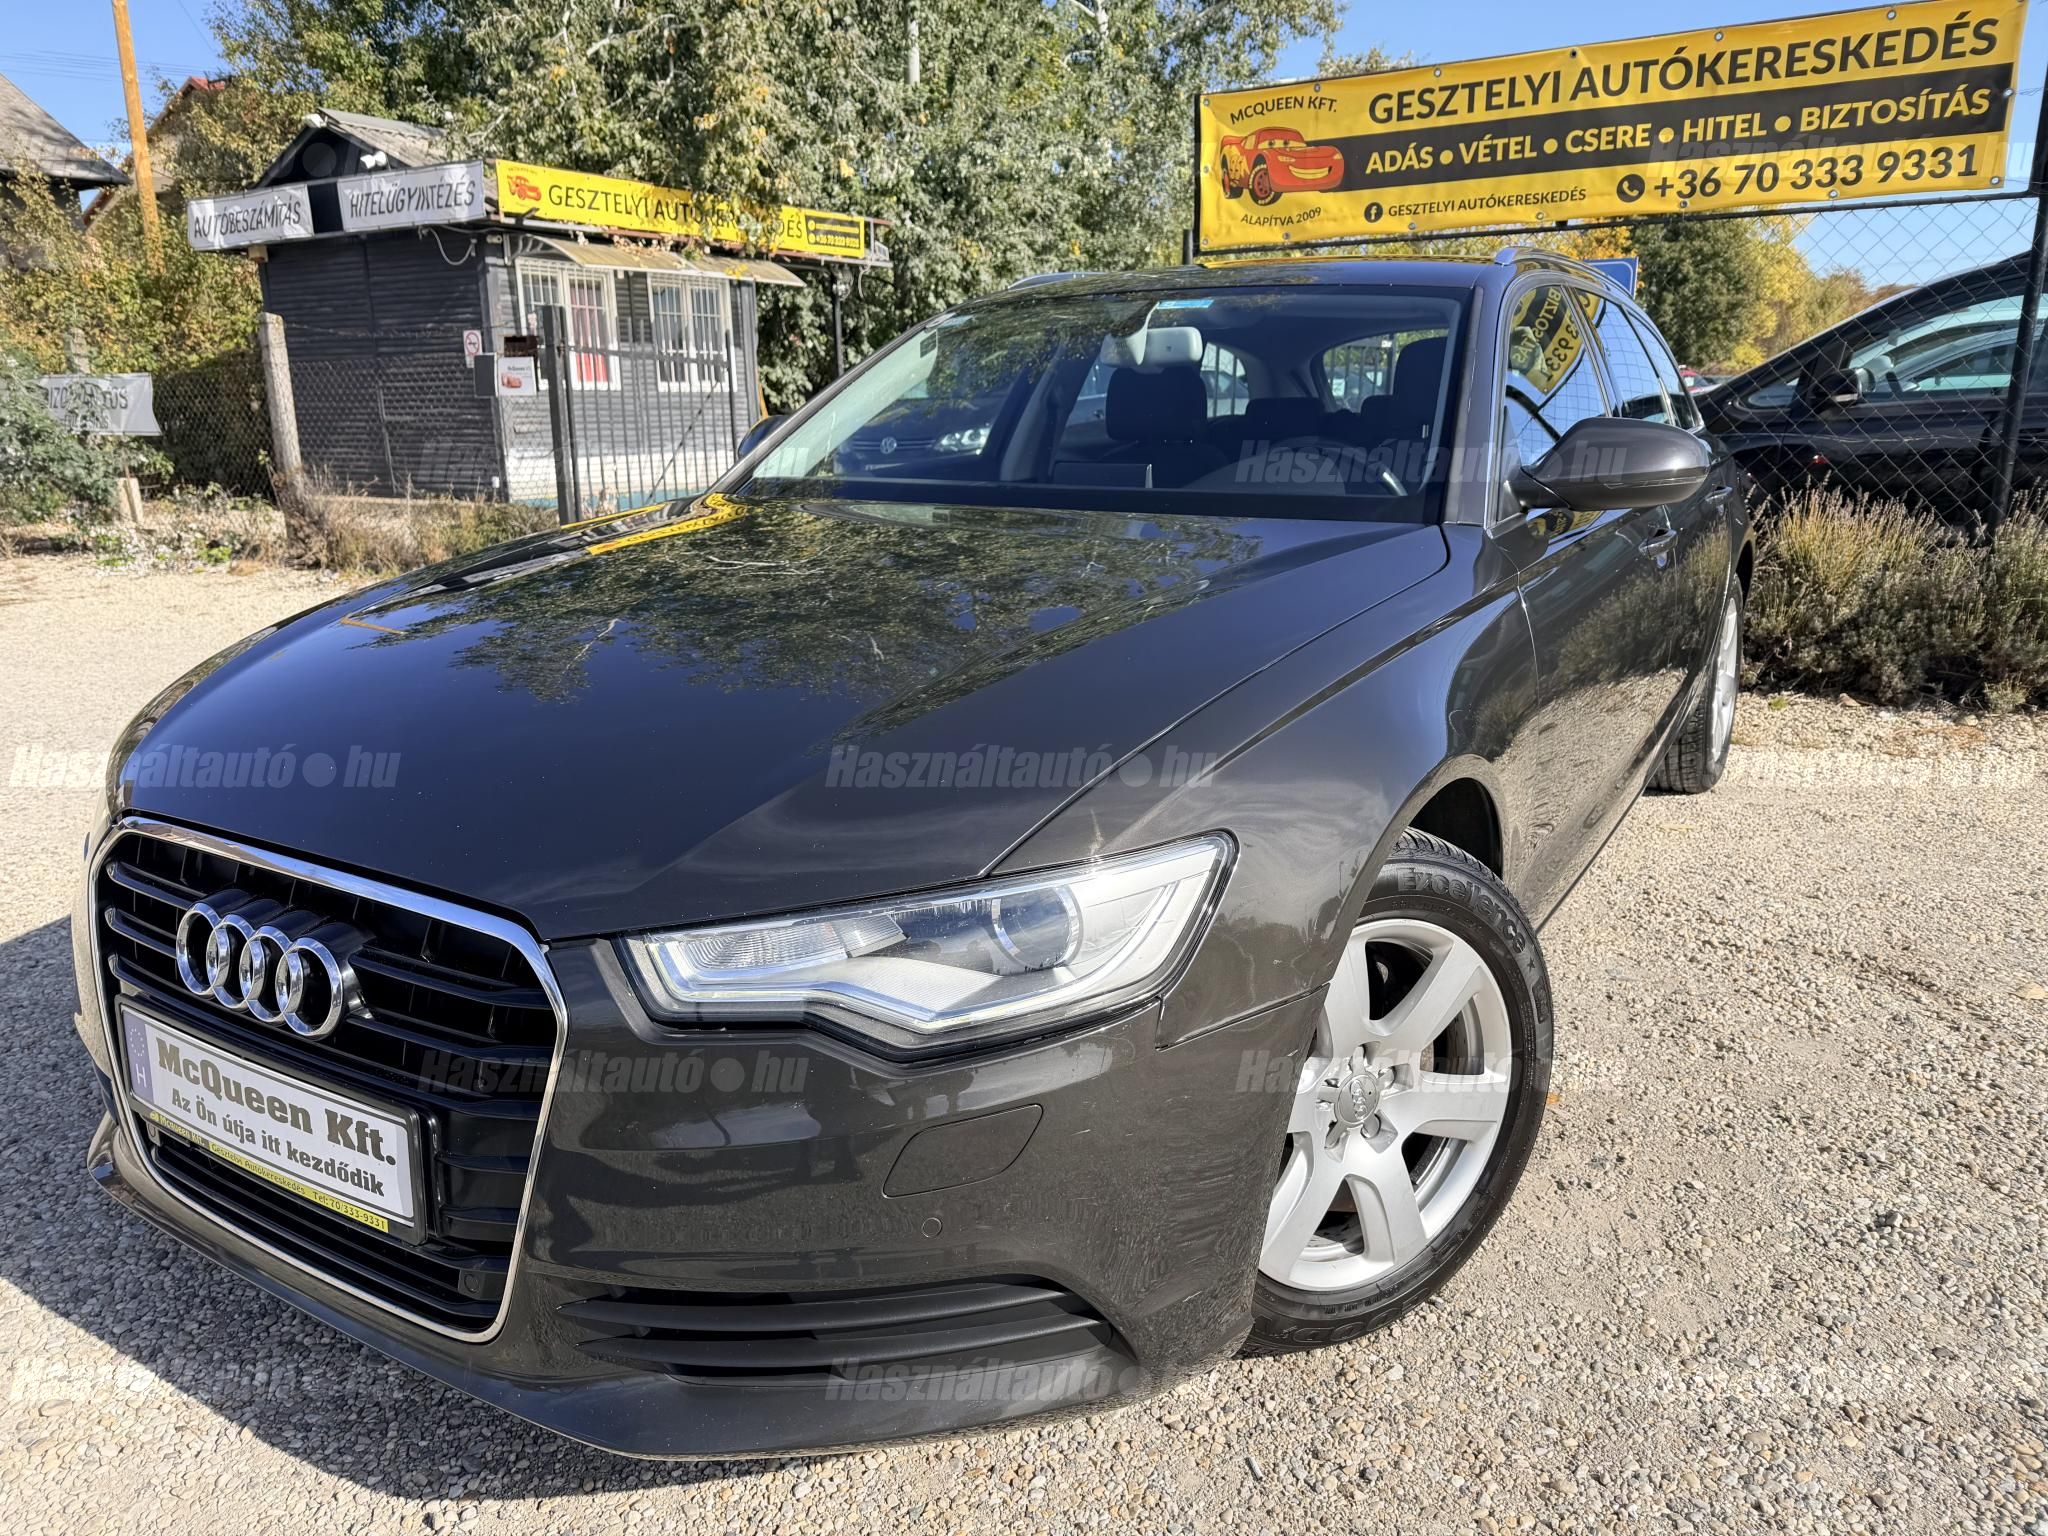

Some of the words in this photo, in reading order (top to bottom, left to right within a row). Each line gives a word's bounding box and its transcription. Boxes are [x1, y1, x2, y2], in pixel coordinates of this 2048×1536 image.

[1369, 69, 1561, 124] GESZTELYI
[1569, 10, 1999, 101] AUTÓKERESKEDÉS
[1230, 96, 1304, 125] MCQUEEN
[1308, 95, 1337, 113] KFT.
[1365, 142, 1433, 174] ADÁS
[1459, 133, 1537, 165] VÉTEL
[1565, 123, 1652, 153] CSERE
[1683, 112, 1767, 144] HITEL
[1799, 84, 1991, 133] BIZTOSÍTÁS
[1654, 166, 1722, 199] +36
[1734, 161, 1779, 195] 70
[1791, 155, 1864, 190] 333
[1877, 144, 1978, 184] 9331
[194, 196, 301, 238] AUTÓBESZÁMÍTÁS
[351, 174, 476, 218] HITELÜGYINTÉZÉS
[549, 184, 649, 218] GESZTELYI
[1241, 212, 1294, 226] ALAPÍTVA
[1296, 206, 1321, 223] 2009
[1388, 200, 1456, 217] GESZTELYI
[1458, 186, 1587, 210] AUTÓKERESKEDÉS
[135, 1063, 147, 1088] H
[156, 1036, 313, 1135] McQueen
[325, 1108, 396, 1166] Kft.
[172, 1088, 191, 1113] Az
[196, 1095, 217, 1127] Ön
[222, 1114, 256, 1145] útja
[261, 1129, 281, 1155] itt
[286, 1140, 384, 1197] kezdődik
